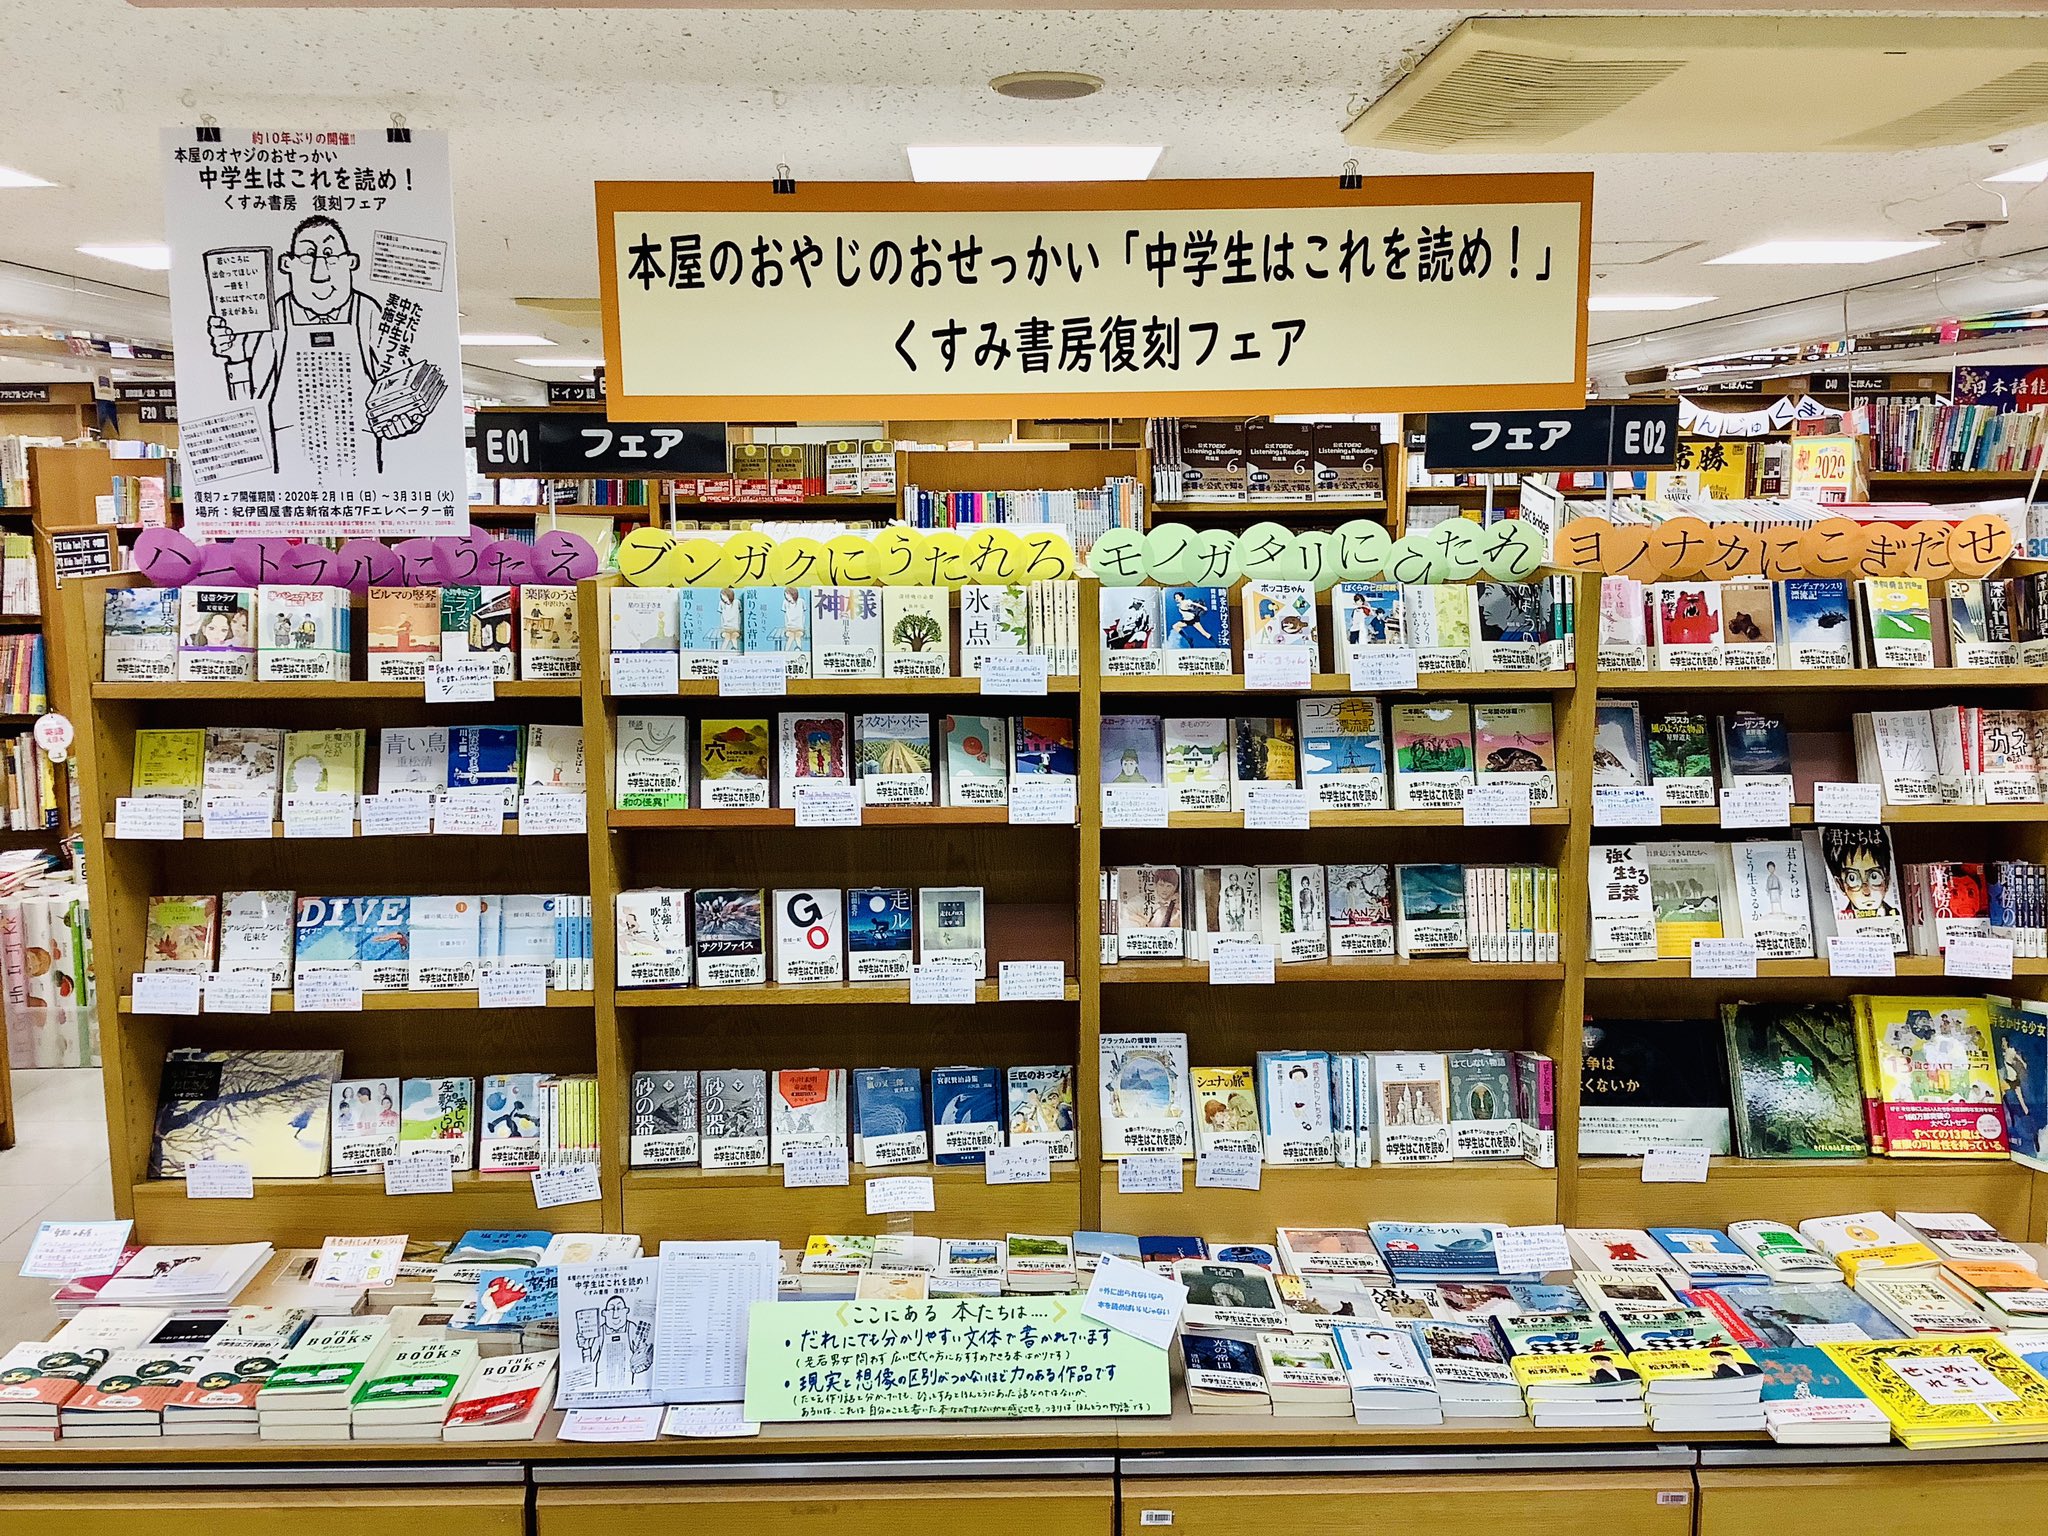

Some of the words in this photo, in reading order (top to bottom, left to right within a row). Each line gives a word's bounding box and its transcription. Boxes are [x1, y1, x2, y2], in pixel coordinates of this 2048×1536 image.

[174, 147, 338, 164] 本屋のオヤジのおせっかい
[199, 166, 414, 192] 中学生はこれを読め！
[223, 194, 298, 212] くすみ書房
[312, 195, 387, 212] 復刻フェア
[626, 226, 1552, 292] 本屋のおやじのおせっかい「中学生はこれを読め！」
[211, 268, 259, 279] 出会ってほしい
[215, 292, 266, 304] 「本にはすべての
[220, 306, 258, 317] 答えがある」
[376, 292, 400, 349] 実施中！
[377, 297, 412, 377] 中学生フェア
[398, 302, 423, 365] ただいま、
[894, 317, 1308, 374] くすみ書房復刻フェア
[1825, 379, 1838, 389] D40
[550, 386, 596, 400] ドイツ語
[141, 406, 157, 420] F20
[1469, 420, 1572, 452] フェア
[1625, 420, 1667, 455] E02
[487, 428, 529, 464] E01
[581, 428, 684, 459] フェア
[1227, 458, 1239, 474] 6
[1294, 459, 1306, 475] 6
[1362, 457, 1374, 473] 6
[1814, 455, 1845, 479] 2020
[1532, 515, 1550, 535] Bridge
[1100, 525, 1530, 585] モノガタリにひたれ
[1570, 523, 2006, 577] ヨノナカにこぎだせ
[148, 541, 583, 588] ハートフルにうたえ
[629, 534, 1066, 589] ブンガクにうたれろ
[371, 588, 437, 601] ビルマの竪琴
[1260, 583, 1305, 593] ボッコちゃん
[1790, 582, 1843, 591] エンデュアランス号
[1791, 591, 1818, 600] 漂流記
[814, 587, 878, 621] 神様
[682, 590, 694, 650] 蹴りたい背中
[746, 590, 758, 650] 蹴りたい背中
[965, 588, 991, 646] 氷点
[1219, 588, 1230, 646] 時をかける少女
[1412, 611, 1420, 645] からくさ
[1423, 611, 1431, 645] からくり
[116, 662, 176, 675] 中学生はこれを読め！
[190, 662, 248, 675] 中学生はこれを読め！
[270, 661, 330, 674] 中学生はこれを読め！
[823, 656, 877, 669] 中学生はこれを読め！
[893, 662, 946, 675] 中学生はこれを読め！
[1305, 701, 1375, 718] コンチキ号
[866, 714, 928, 727] スタンド・バイ・ミー
[1336, 718, 1375, 733] 漂流記
[1664, 716, 1690, 724] アラスカ
[1731, 719, 1779, 730] ノーザンライツ
[1651, 723, 1705, 734] 風のような物語
[384, 732, 446, 755] 青い鳥
[1666, 733, 1691, 742] 星野道夫
[704, 741, 725, 762] 穴
[396, 755, 433, 768] 重松清
[627, 775, 682, 788] 中学生はこれを読め！
[711, 790, 766, 803] 中学生はこれを読め！
[876, 786, 929, 797] 中学生はこれを読め！
[1319, 785, 1384, 802] 中学生はこれを読め！
[1830, 828, 1883, 846] 君たちは
[1606, 848, 1632, 864] 強く
[1613, 866, 1649, 885] 生きる
[1785, 847, 1801, 899] 君たちは
[1606, 883, 1640, 902] 言葉
[1745, 847, 1762, 922] どう生きるか
[2000, 865, 2016, 927] 路傍の
[661, 896, 673, 933] 風が強く
[889, 890, 910, 930] 走ル
[939, 909, 964, 917] 走れメロス
[1341, 908, 1391, 919] MANZAI
[227, 924, 284, 933] アルジャーノンに
[650, 907, 660, 943] 吹いている
[243, 933, 268, 942] 花束を
[1756, 935, 1811, 951] 中学生はこれを読め！
[700, 941, 754, 953] サクリファイス
[419, 969, 475, 983] 中学生はこれを読め！
[1100, 1037, 1158, 1045] ブラッカムの爆撃機
[1450, 1058, 1506, 1068] はてしない物語
[1580, 1056, 1616, 1071] 争は
[1782, 1060, 1811, 1078] 森へ
[937, 1074, 978, 1085] 宮沢賢治詩集
[1009, 1069, 1069, 1081] 三匹のおっさん
[1197, 1075, 1246, 1089] シュナの旅
[439, 1080, 454, 1131] 座敷わらし
[635, 1076, 656, 1136] 砂の器
[683, 1075, 696, 1130] 松本清張
[704, 1076, 726, 1136] 砂の器
[752, 1075, 765, 1130] 松本清張
[454, 1097, 468, 1129] 愛しの
[1930, 1119, 1975, 1127] 大ベストセラー
[1124, 1132, 1188, 1147] 中学生はこれを読め！
[1385, 1139, 1450, 1155] 中学生はこれを読め！
[1457, 1134, 1521, 1150] 中学生はこれを読め！
[1891, 1140, 2006, 1151] 無限の可能性を持っている。
[1379, 1226, 1461, 1236] ウミガメと少年
[1309, 1259, 1379, 1267] 中学生はこれを読め！
[575, 1276, 650, 1289] 中学生はこれを読め！
[932, 1280, 999, 1288] スタンド・バイ・ミー
[853, 1305, 937, 1324] ここにある
[1097, 1300, 1171, 1316] 本を読めばいいじゃない
[1215, 1314, 1288, 1325] 中学生はこれを読め！
[1620, 1310, 1705, 1323] 数の悪魔
[307, 1333, 373, 1347] BOOKS
[801, 1327, 1113, 1347] だれにでも分かりやすい文体で書かれています
[395, 1348, 462, 1362] BOOKS
[1213, 1339, 1232, 1370] 光の帝国
[482, 1359, 547, 1377] BOOKS
[1435, 1367, 1513, 1379] 中学生はこれを読め！
[1648, 1362, 1690, 1371] 松丸亮吾
[1901, 1364, 1980, 1378] せいめい
[799, 1364, 1118, 1389] 現実と想像の区別がつかないほど力のある作品です
[1201, 1377, 1264, 1388] 中学生はこれを読め！
[1927, 1378, 1989, 1389] れきし
